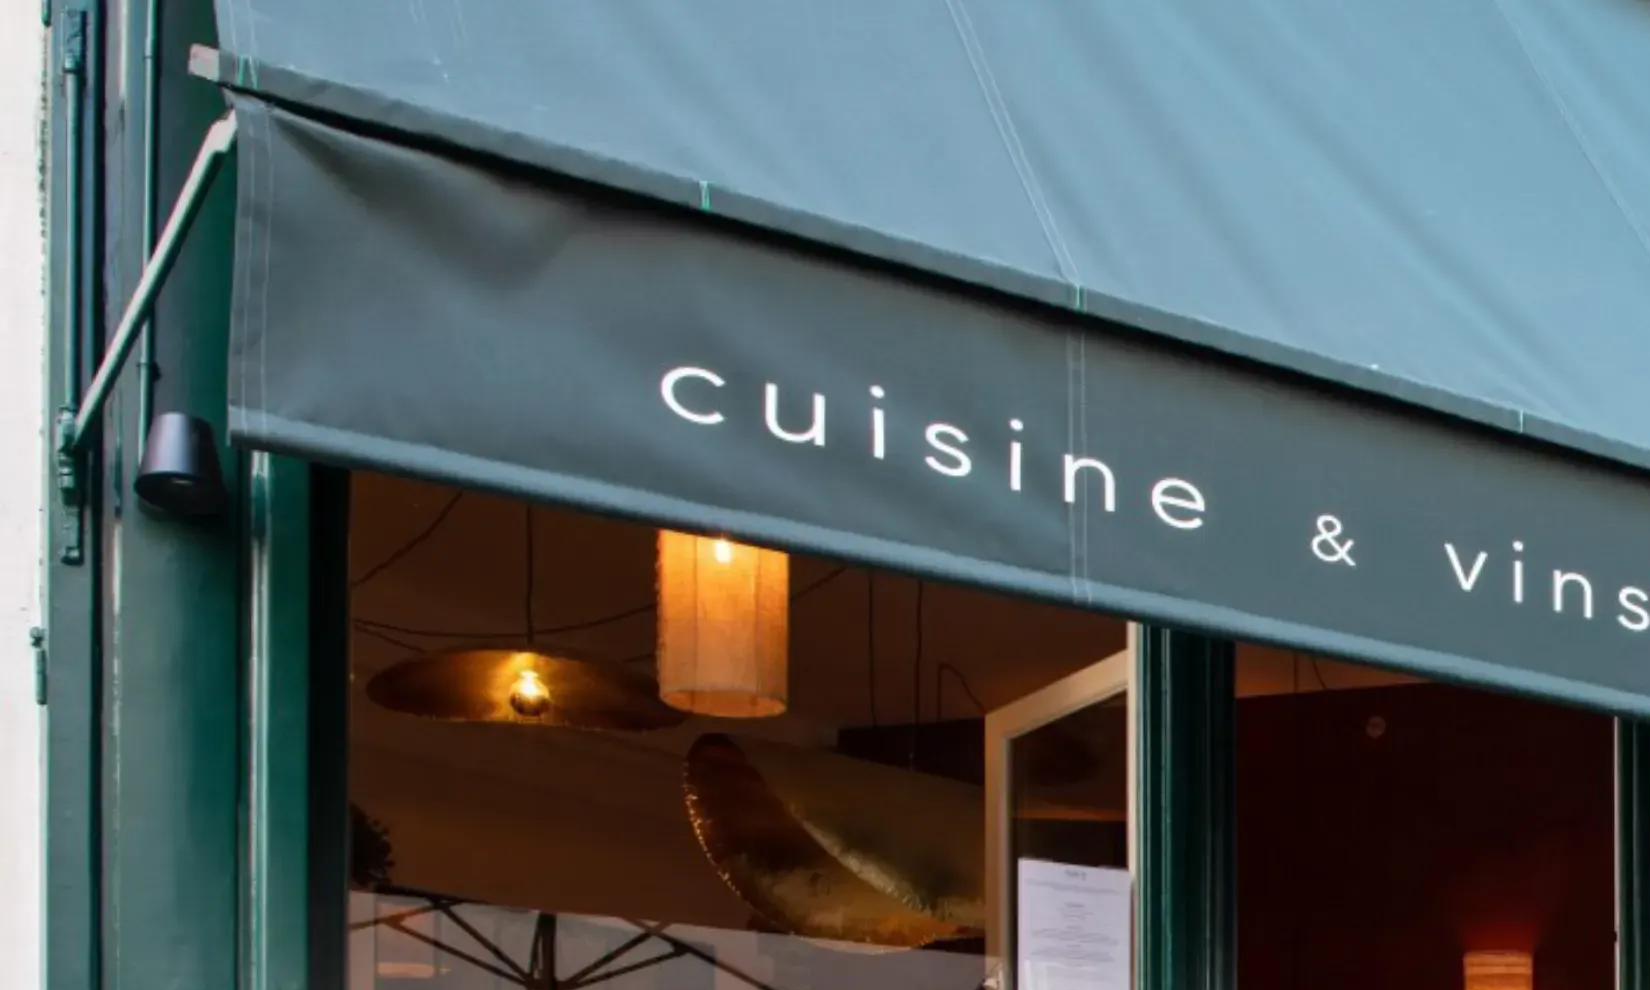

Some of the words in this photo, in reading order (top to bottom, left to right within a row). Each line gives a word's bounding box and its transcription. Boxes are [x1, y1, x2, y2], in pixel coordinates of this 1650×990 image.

[660, 366, 1206, 530] cuisine
[1311, 514, 1356, 566] &
[1443, 540, 1650, 631] vins
